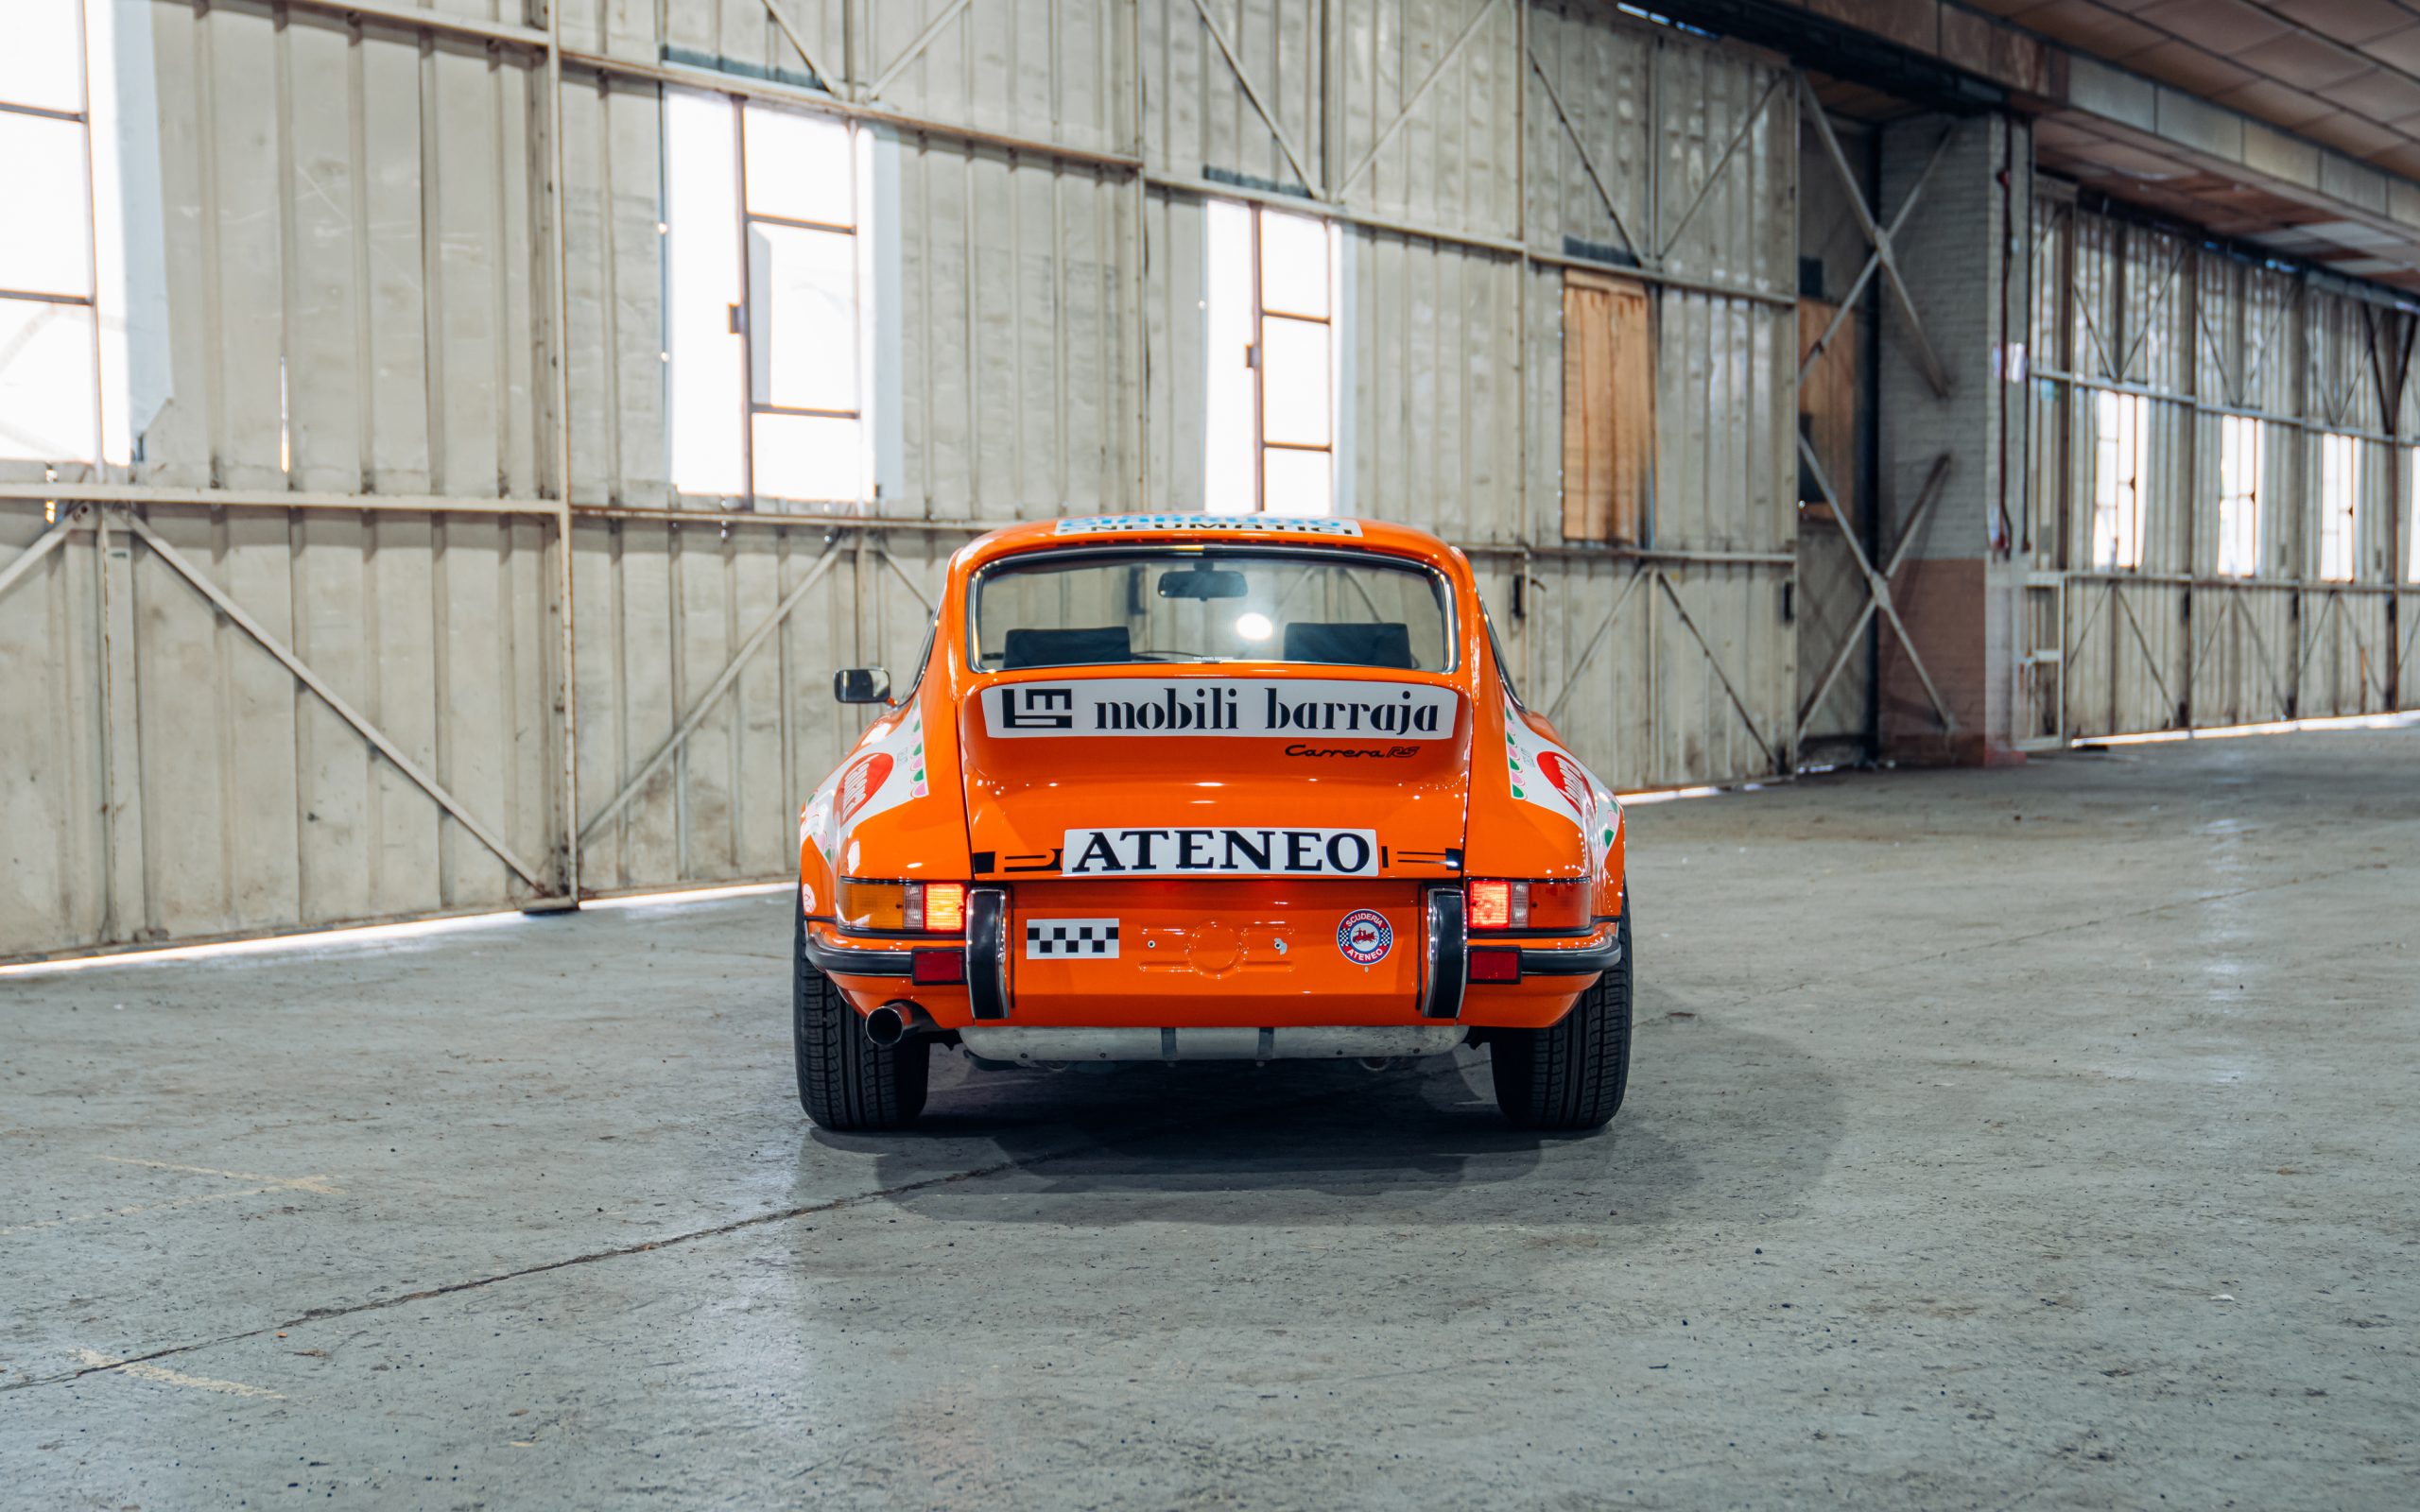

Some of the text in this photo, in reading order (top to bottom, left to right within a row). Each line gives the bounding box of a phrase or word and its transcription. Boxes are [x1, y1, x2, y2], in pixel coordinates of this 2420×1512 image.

[1094, 687, 1238, 730] mobili
[1264, 687, 1439, 735] barraja
[1285, 744, 1421, 758] Carrera RS
[1071, 831, 1370, 872] ATENEO
[1346, 914, 1383, 926] SCUDERIA
[1347, 949, 1383, 960] ATENEO
